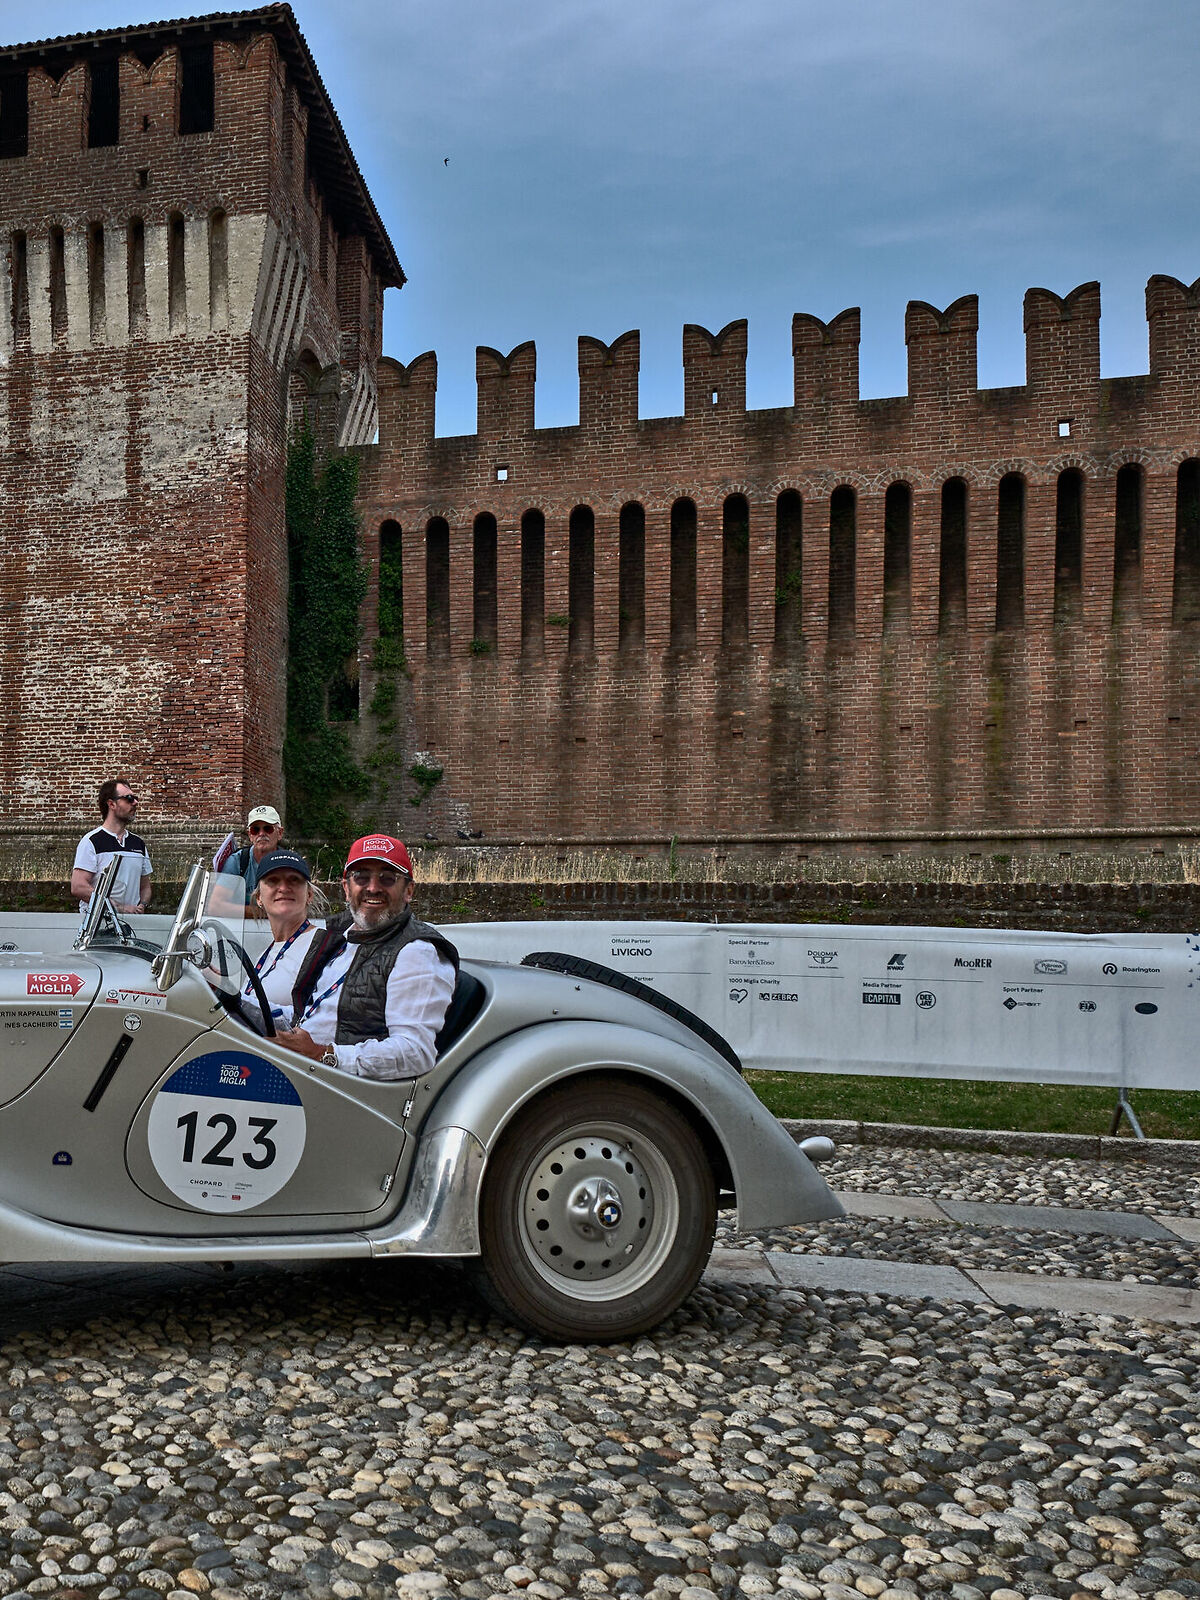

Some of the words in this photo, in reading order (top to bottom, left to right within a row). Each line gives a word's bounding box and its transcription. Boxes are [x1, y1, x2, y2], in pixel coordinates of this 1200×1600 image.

[611, 948, 653, 957] LIVIGNO
[1122, 966, 1160, 974] Roarington
[30, 984, 72, 993] MIGLIA
[1003, 986, 1020, 994] Sport
[771, 993, 799, 1002] ZEBRA
[868, 993, 899, 1003] CAPITAL
[220, 1069, 240, 1078] 1000
[219, 1076, 247, 1086] MIGLIA
[177, 1110, 278, 1170] 123
[189, 1179, 223, 1187] CHOPARD
